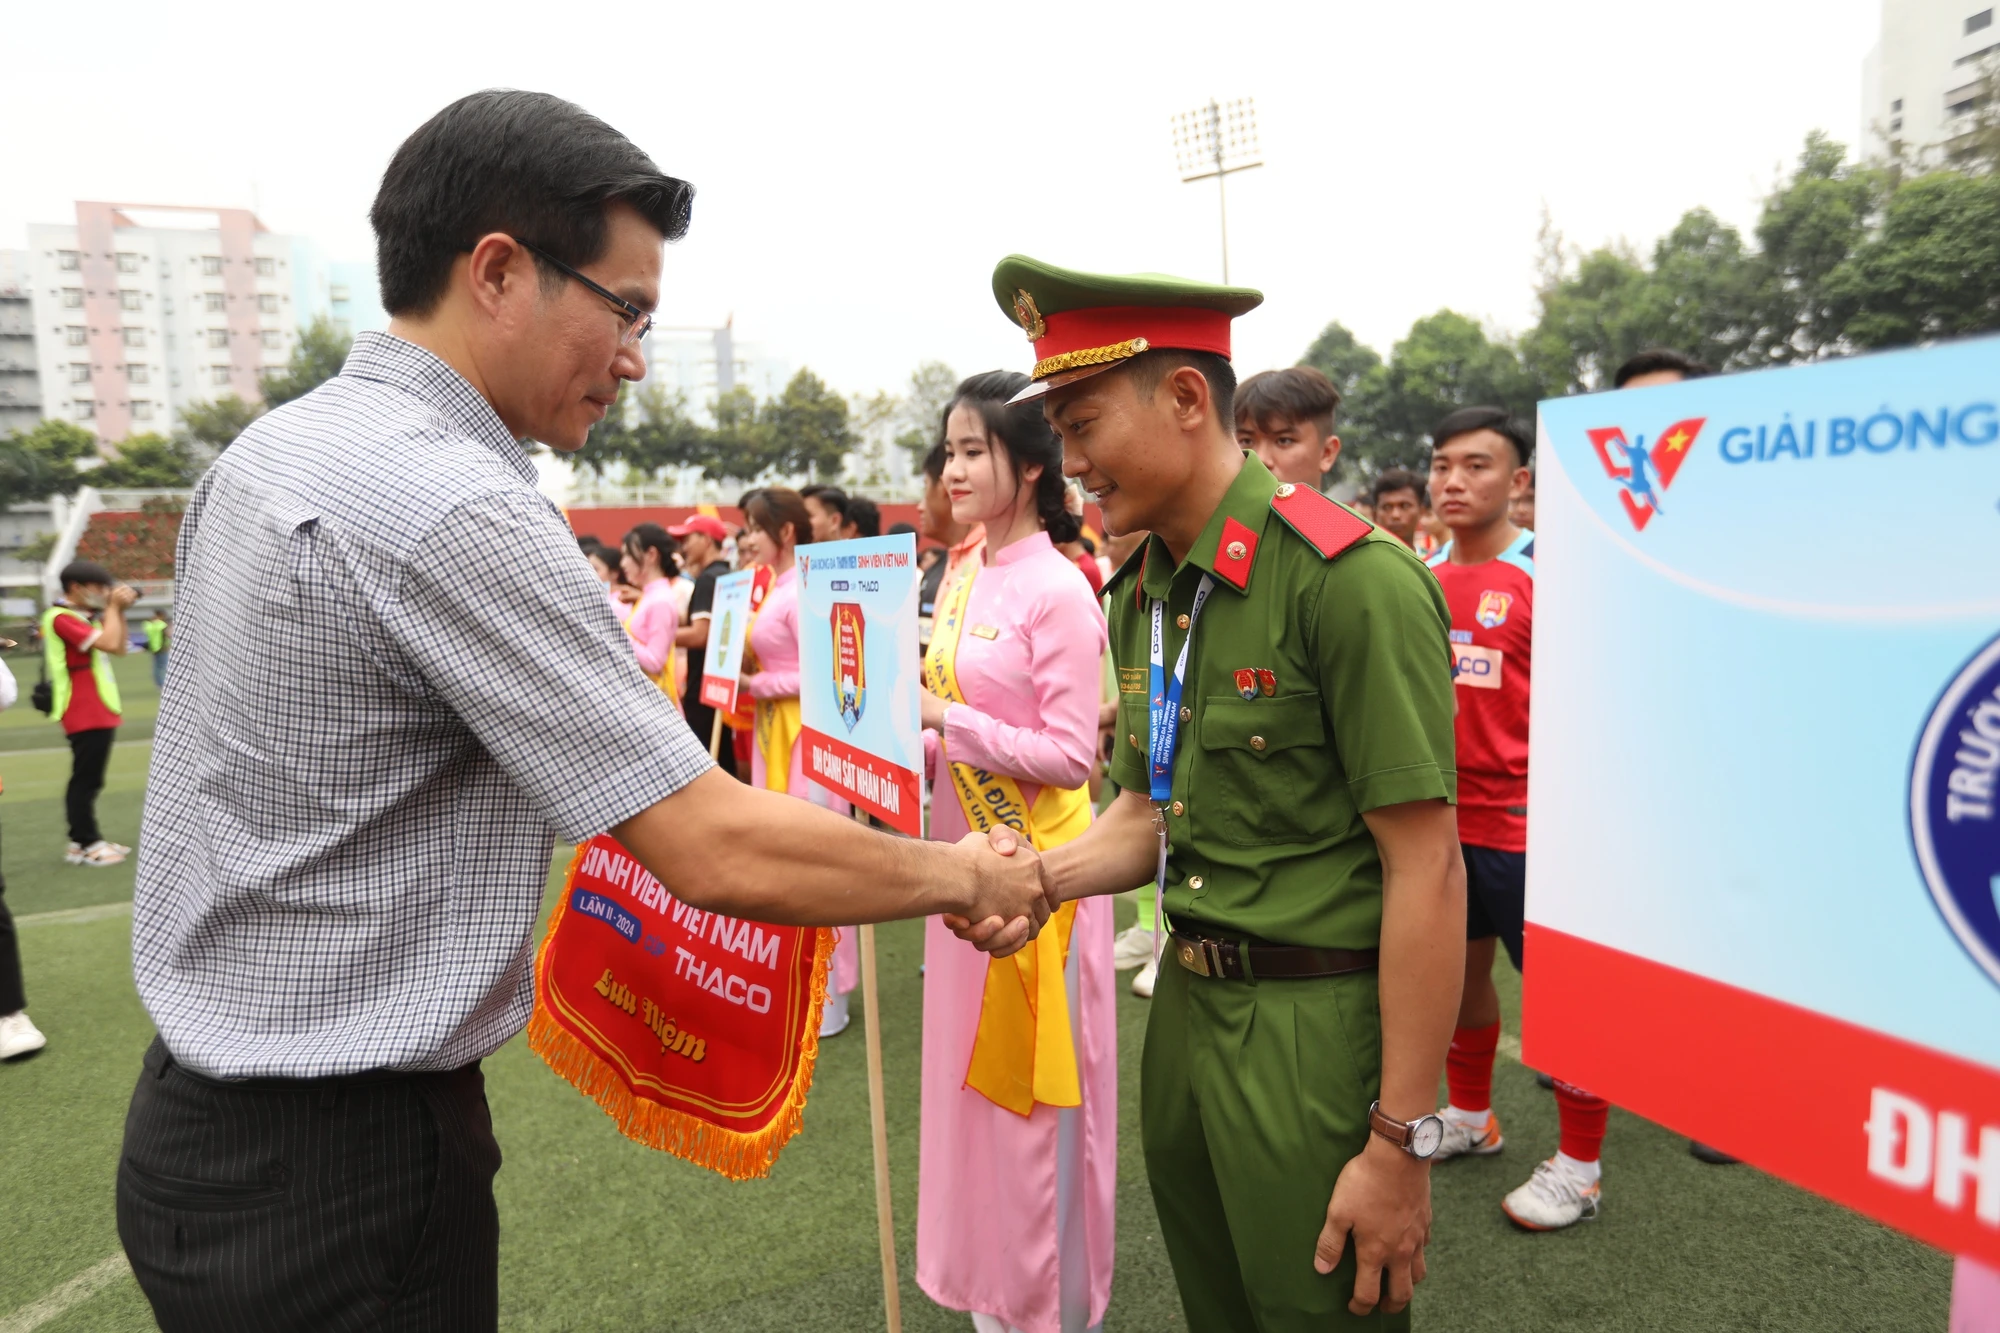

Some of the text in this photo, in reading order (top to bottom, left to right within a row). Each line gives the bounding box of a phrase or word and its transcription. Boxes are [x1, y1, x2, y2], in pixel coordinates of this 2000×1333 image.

[1718, 401, 2000, 465] GIẢI BÓNG
[894, 552, 909, 568] NAM
[1153, 603, 1161, 654] THACO
[1459, 656, 1491, 676] CO
[823, 744, 842, 784] CẢNH
[842, 754, 856, 792] SÁT
[857, 763, 880, 804] NHÂN
[880, 772, 900, 815] DÂN
[1946, 685, 2000, 822] TRƯỜ
[580, 895, 606, 917] LẦN
[615, 913, 636, 938] 2024
[581, 844, 634, 890] SINH
[709, 914, 781, 970] NAM
[675, 945, 772, 1014] THACO
[1863, 1086, 2000, 1229] ĐH
